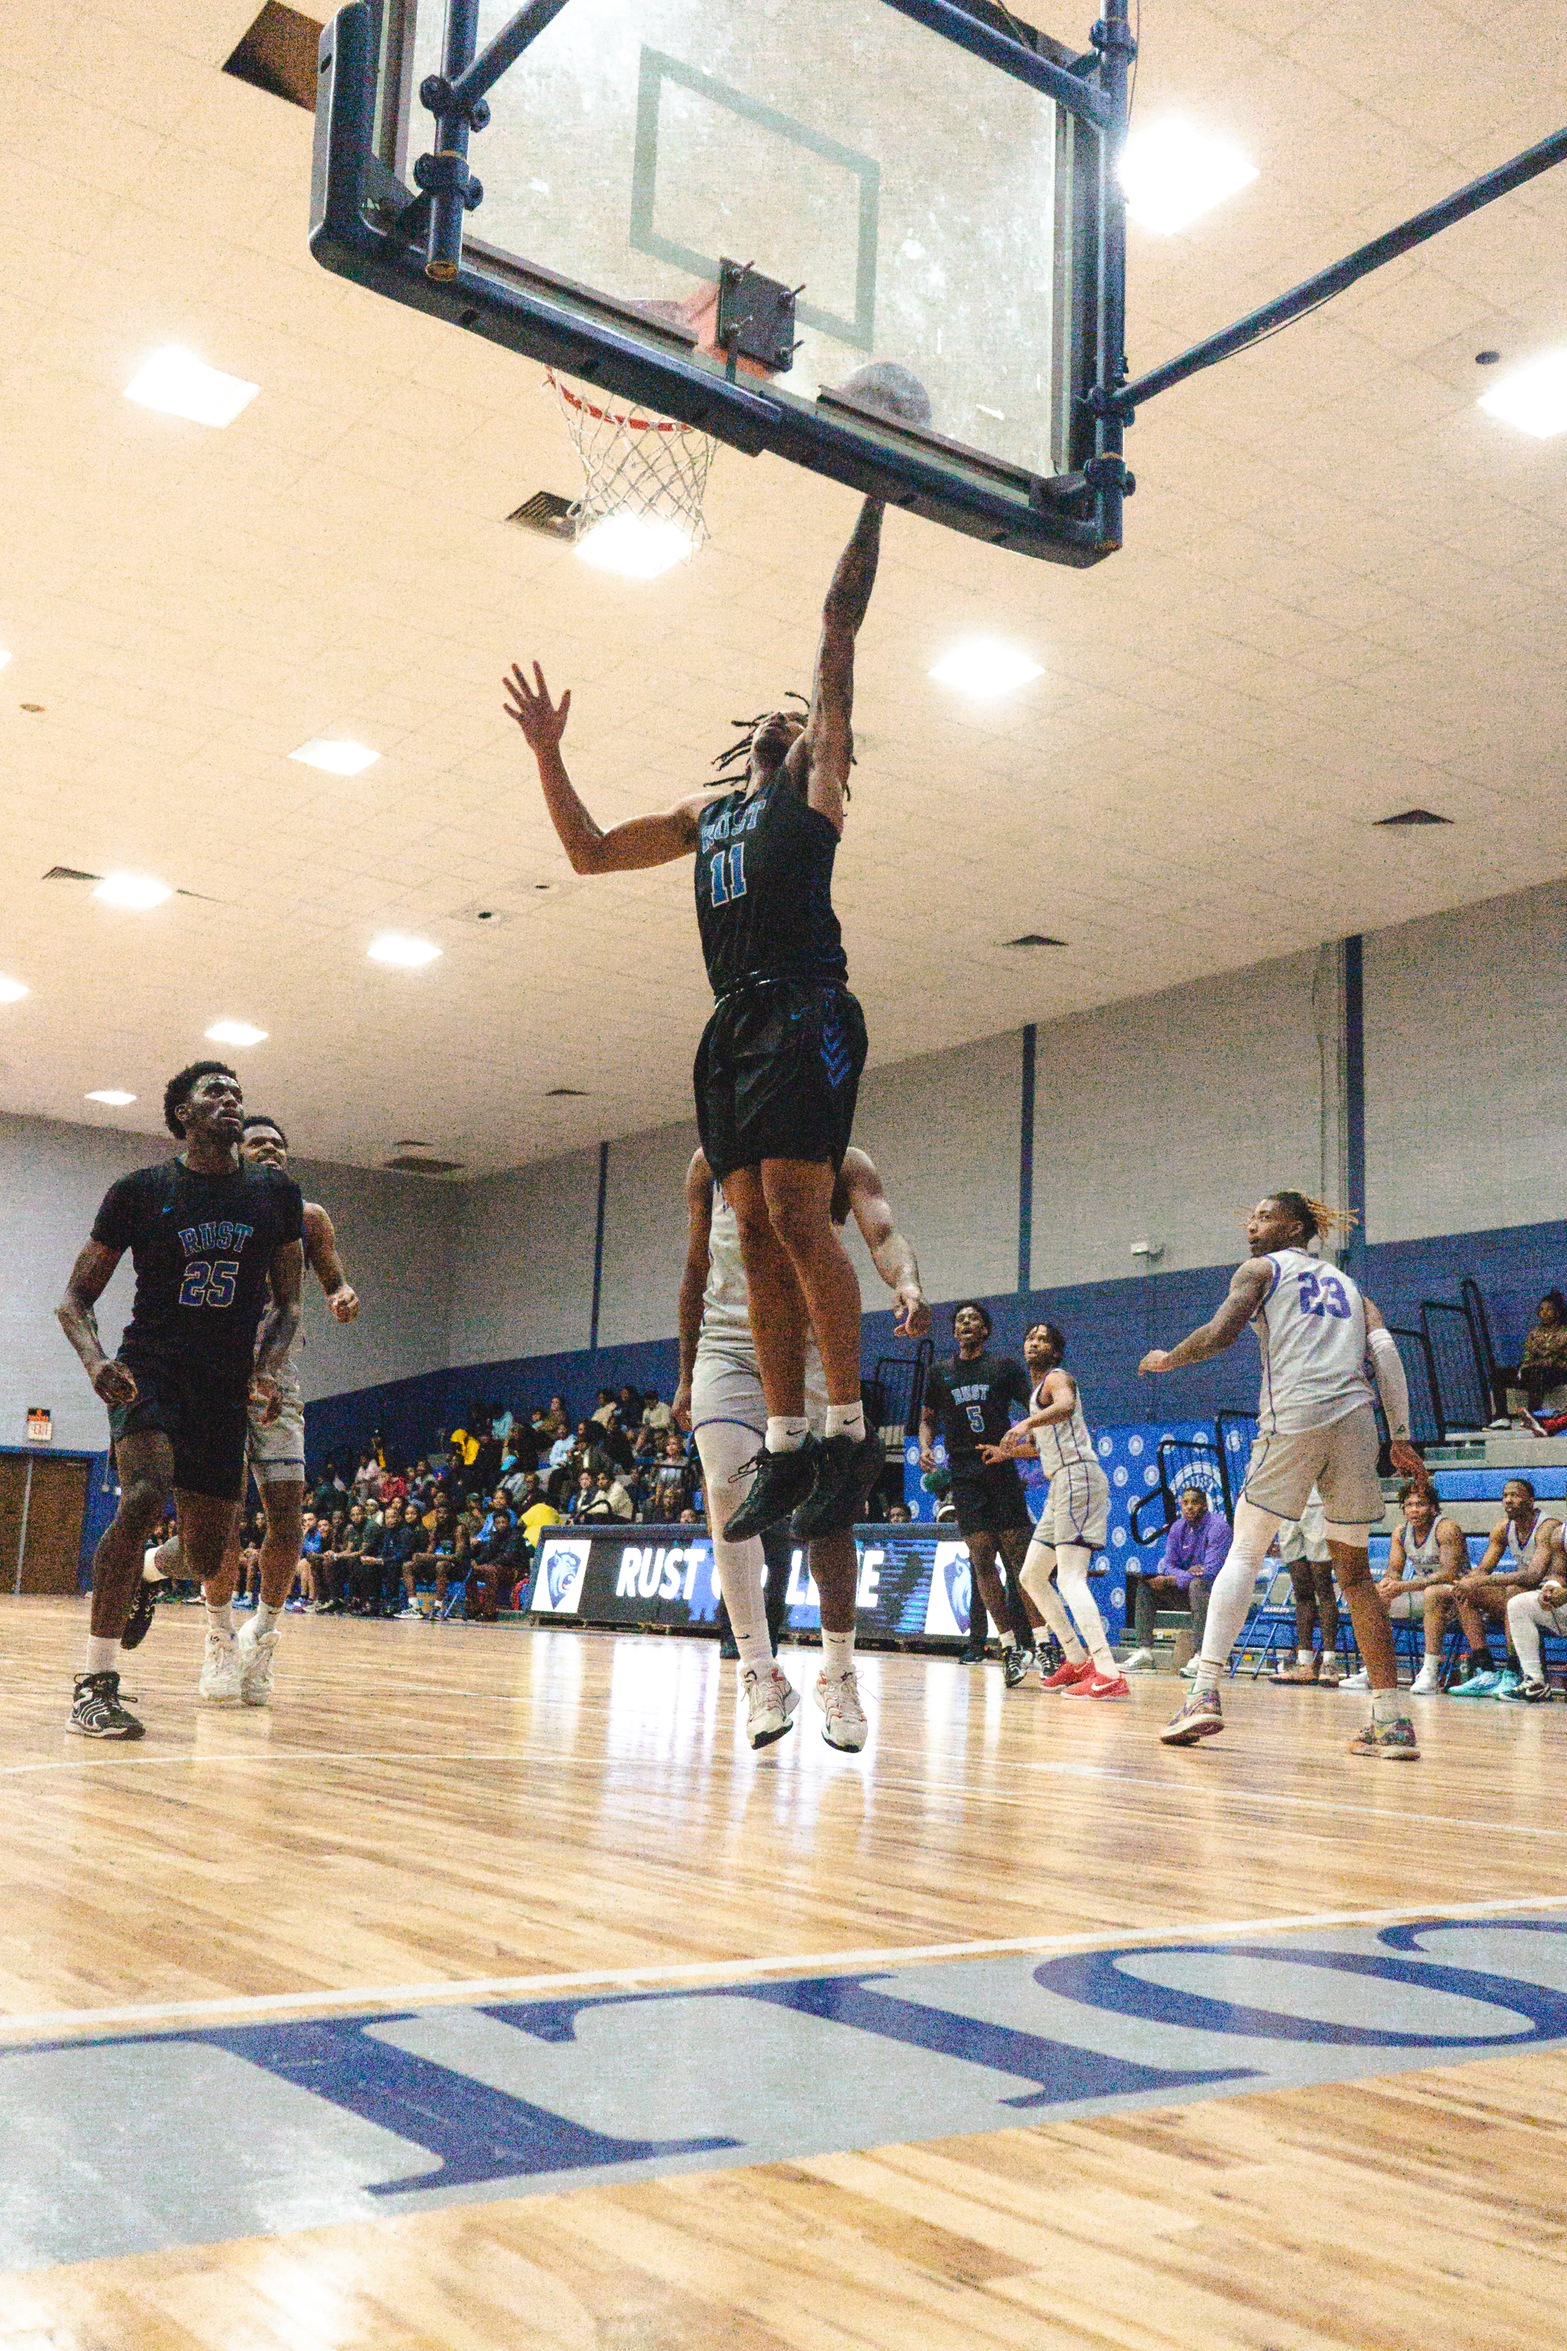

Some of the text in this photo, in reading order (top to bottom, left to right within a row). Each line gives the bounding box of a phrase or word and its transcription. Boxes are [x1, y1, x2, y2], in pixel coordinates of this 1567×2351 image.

[701, 799, 766, 854] RUST
[710, 842, 747, 907] 11
[177, 1220, 254, 1257] RUST
[177, 1259, 240, 1308] 25
[1298, 1271, 1352, 1319] 23
[965, 1405, 985, 1434] 5
[615, 1547, 705, 1600] RUST
